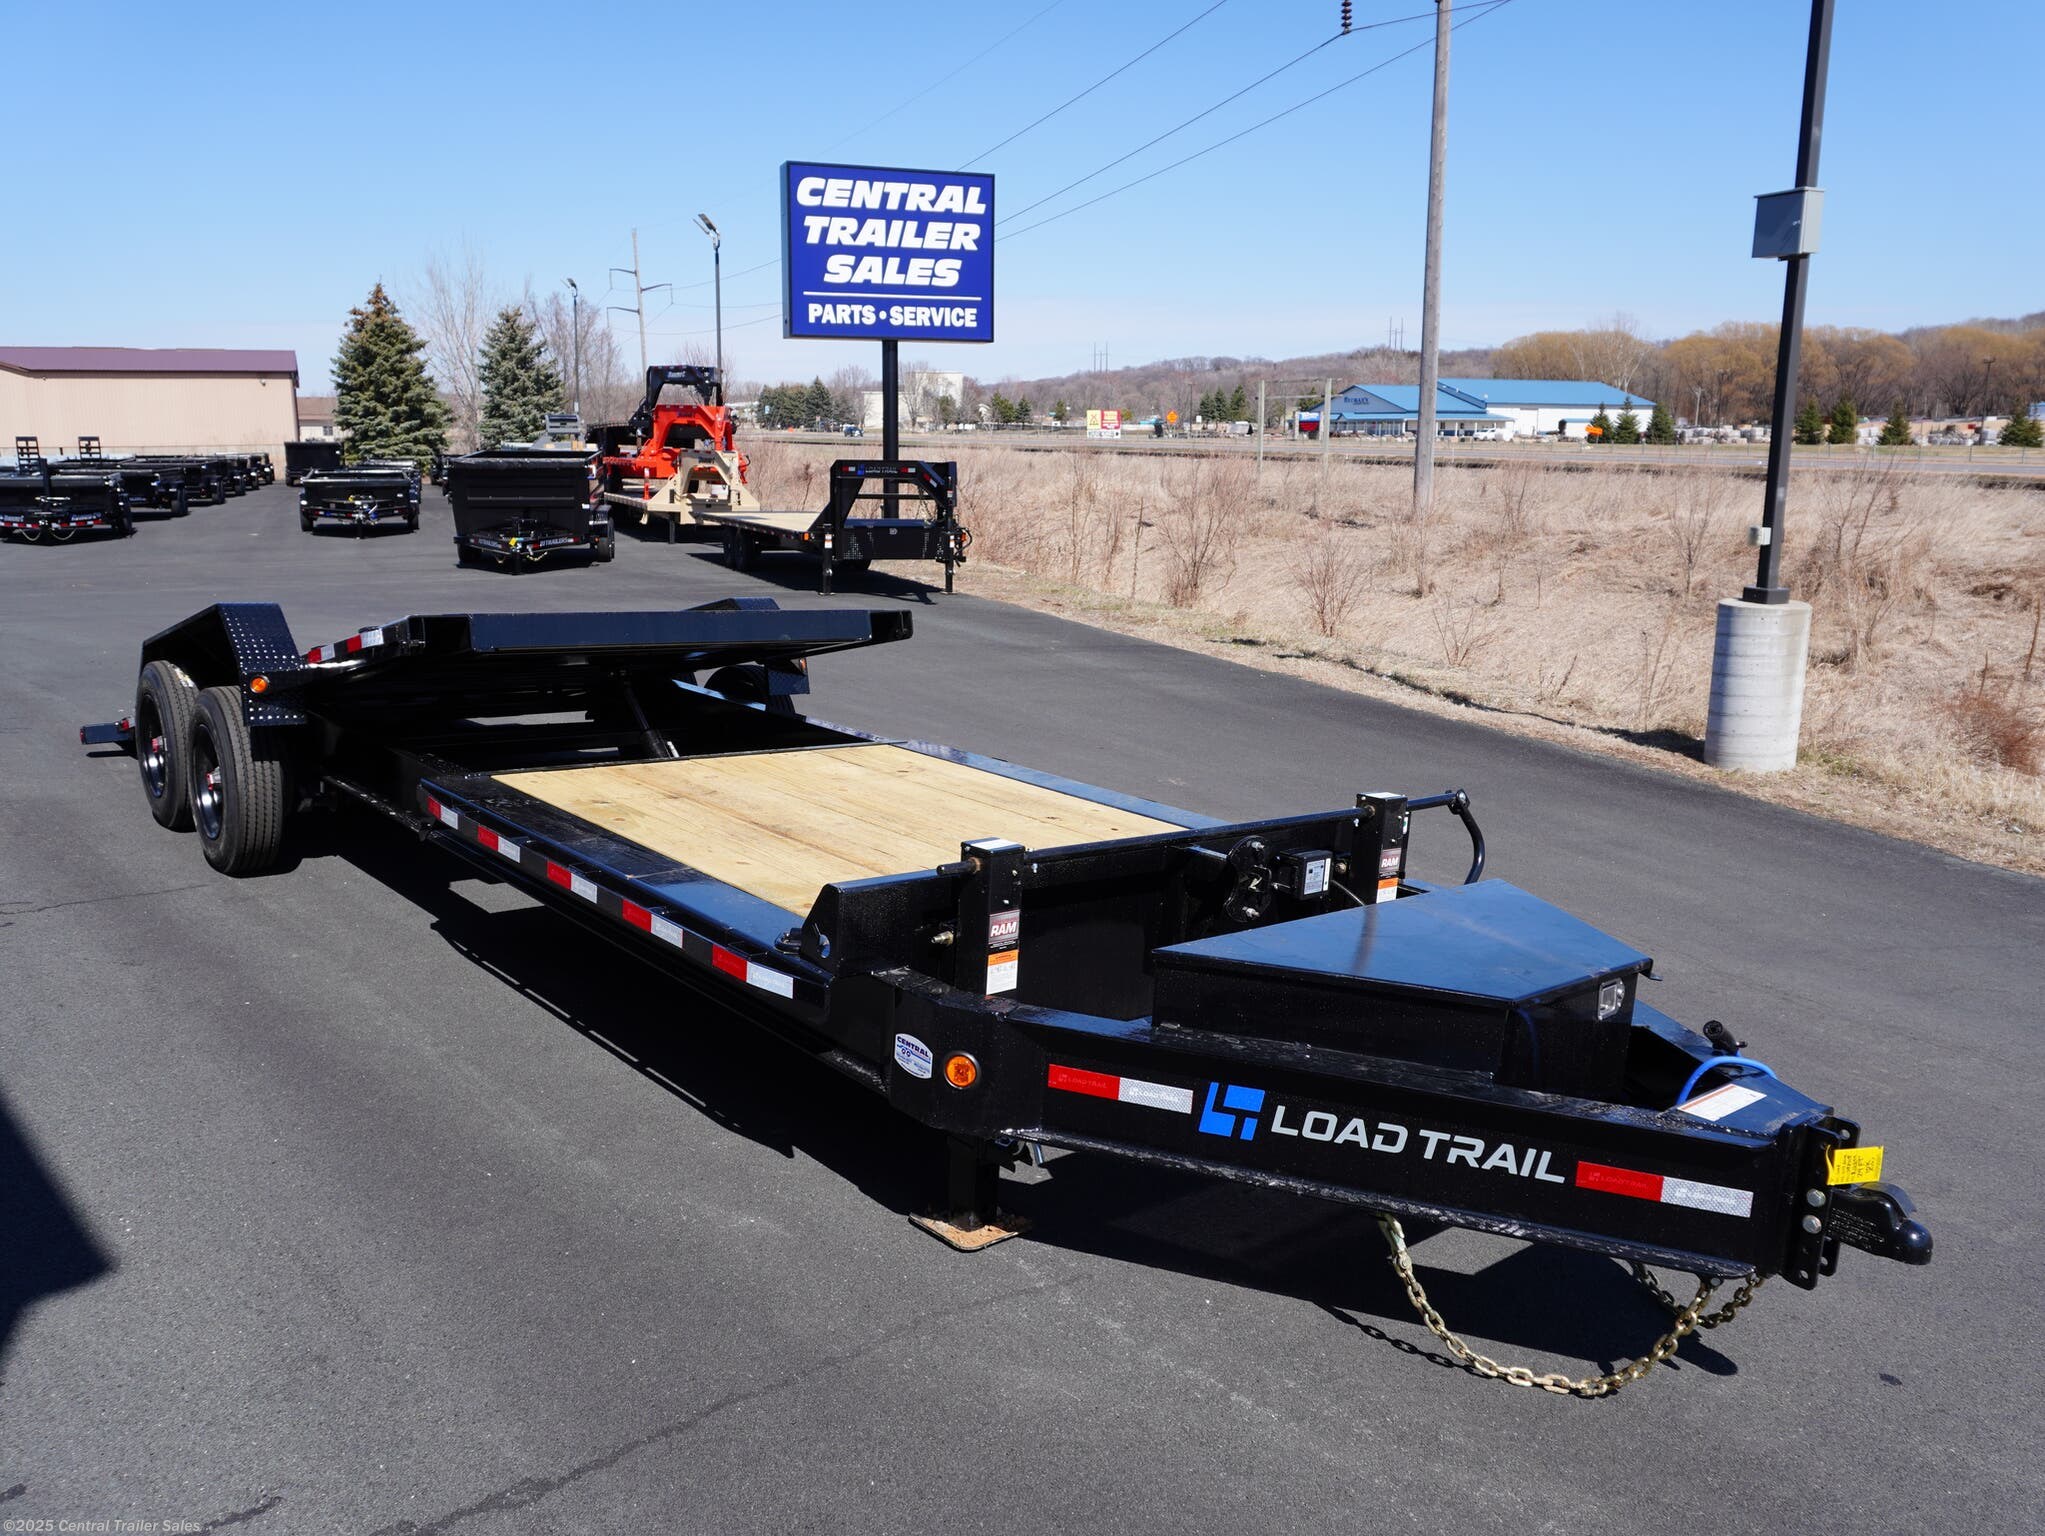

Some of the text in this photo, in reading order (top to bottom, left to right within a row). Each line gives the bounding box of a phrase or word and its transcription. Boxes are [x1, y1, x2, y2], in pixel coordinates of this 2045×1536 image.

[796, 176, 986, 214] CENTRAL
[803, 216, 981, 250] TRAILER
[824, 254, 962, 287] SALES
[808, 303, 978, 328] PARTS SERVICE
[1381, 858, 1398, 868] RAM
[990, 922, 1017, 937] RAM
[896, 1036, 930, 1058] CENTRAL
[1270, 1105, 1565, 1184] LOAD TRAIL
